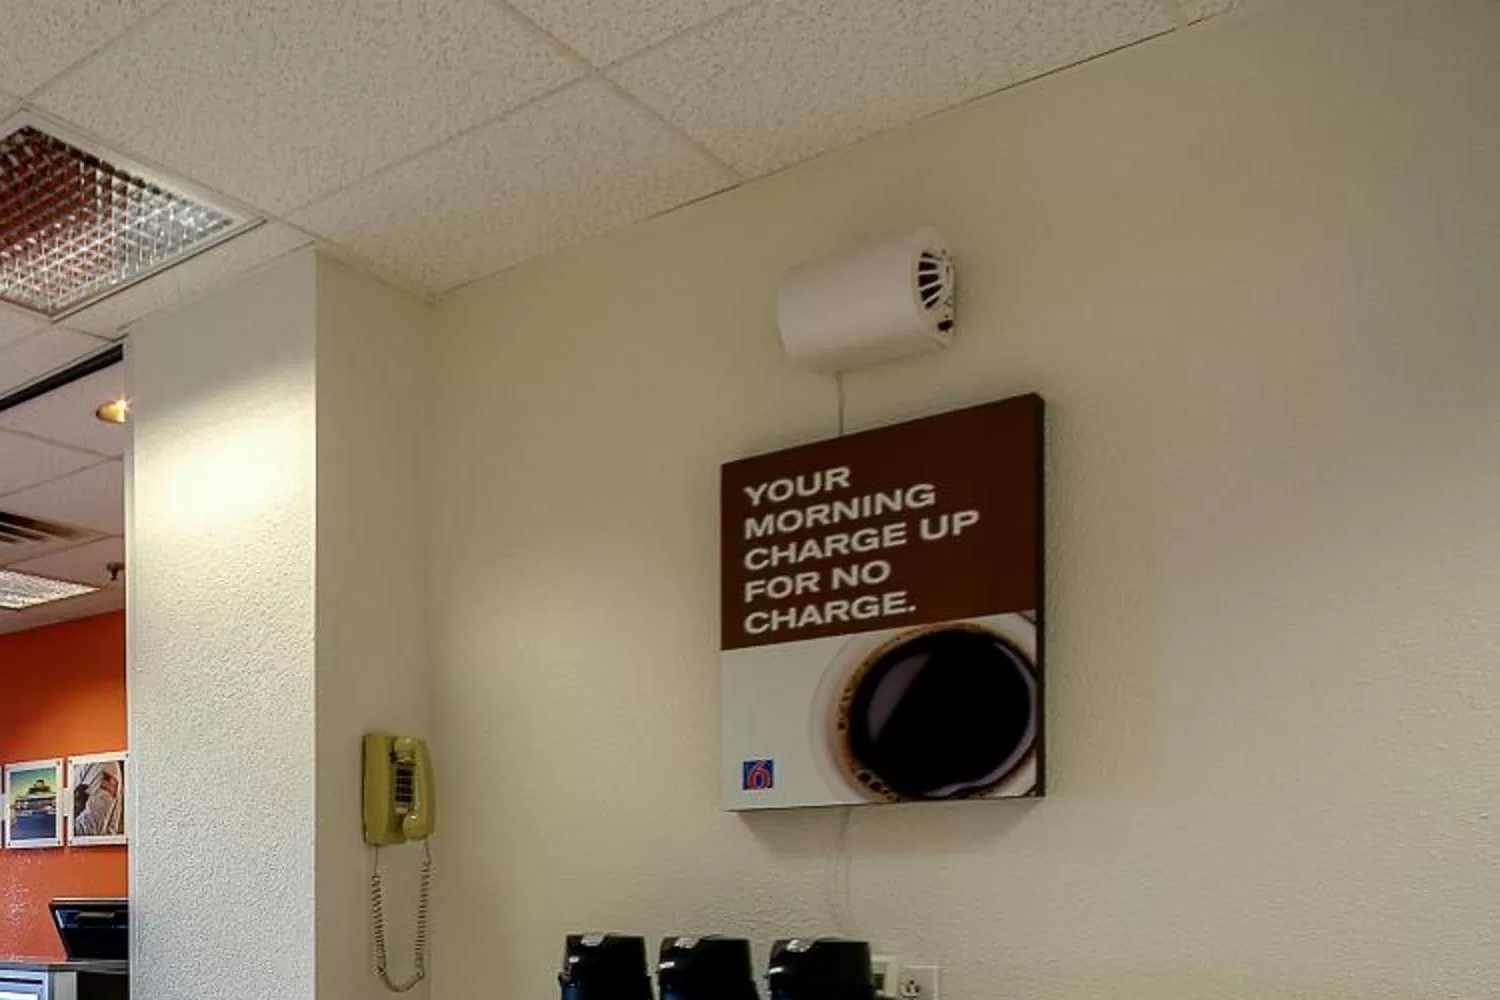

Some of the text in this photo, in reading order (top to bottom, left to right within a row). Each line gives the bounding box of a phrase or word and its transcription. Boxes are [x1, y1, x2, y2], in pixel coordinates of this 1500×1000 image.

[743, 466, 851, 507] YOUR
[743, 483, 936, 540] MORNING
[743, 510, 980, 571] CHARGE UP
[744, 560, 891, 603] FOR NO
[743, 591, 916, 634] CHARGE.
